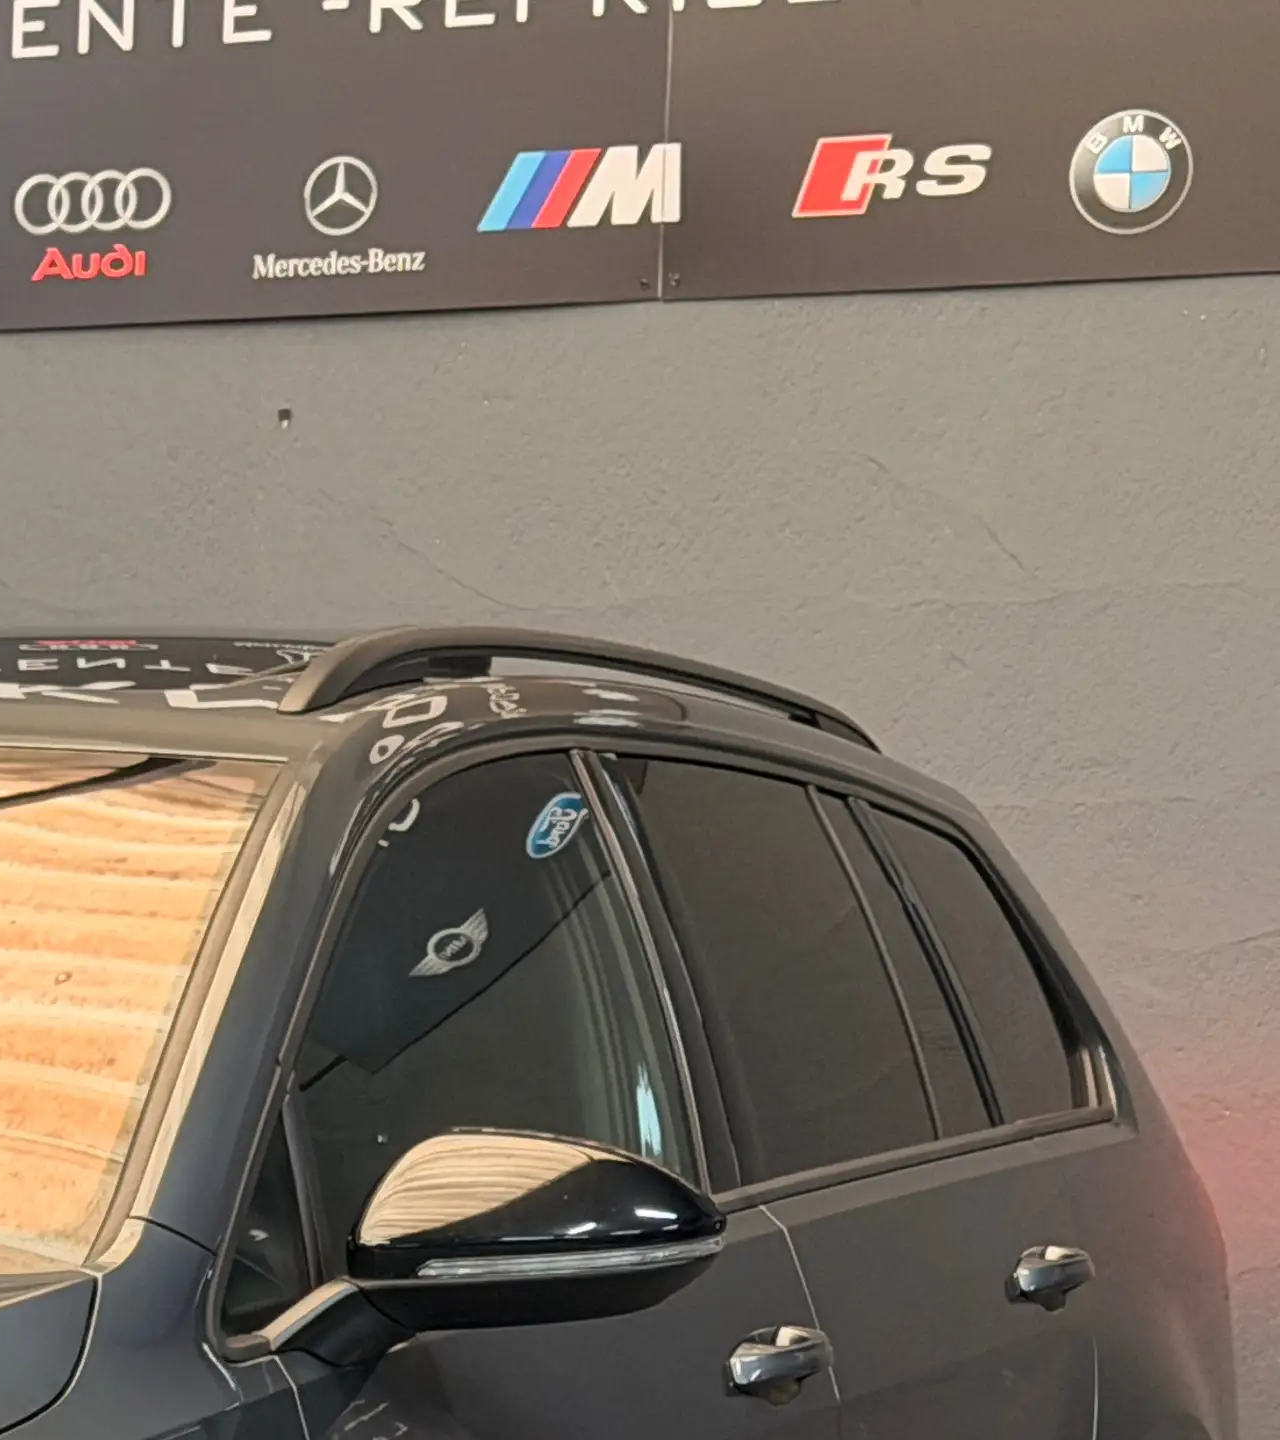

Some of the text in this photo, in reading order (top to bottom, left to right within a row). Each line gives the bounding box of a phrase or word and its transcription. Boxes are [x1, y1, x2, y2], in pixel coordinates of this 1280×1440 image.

[1085, 114, 1182, 154] BMW
[840, 143, 992, 202] RS
[31, 243, 146, 281] Audi
[252, 248, 426, 280] Mercedes-Benz
